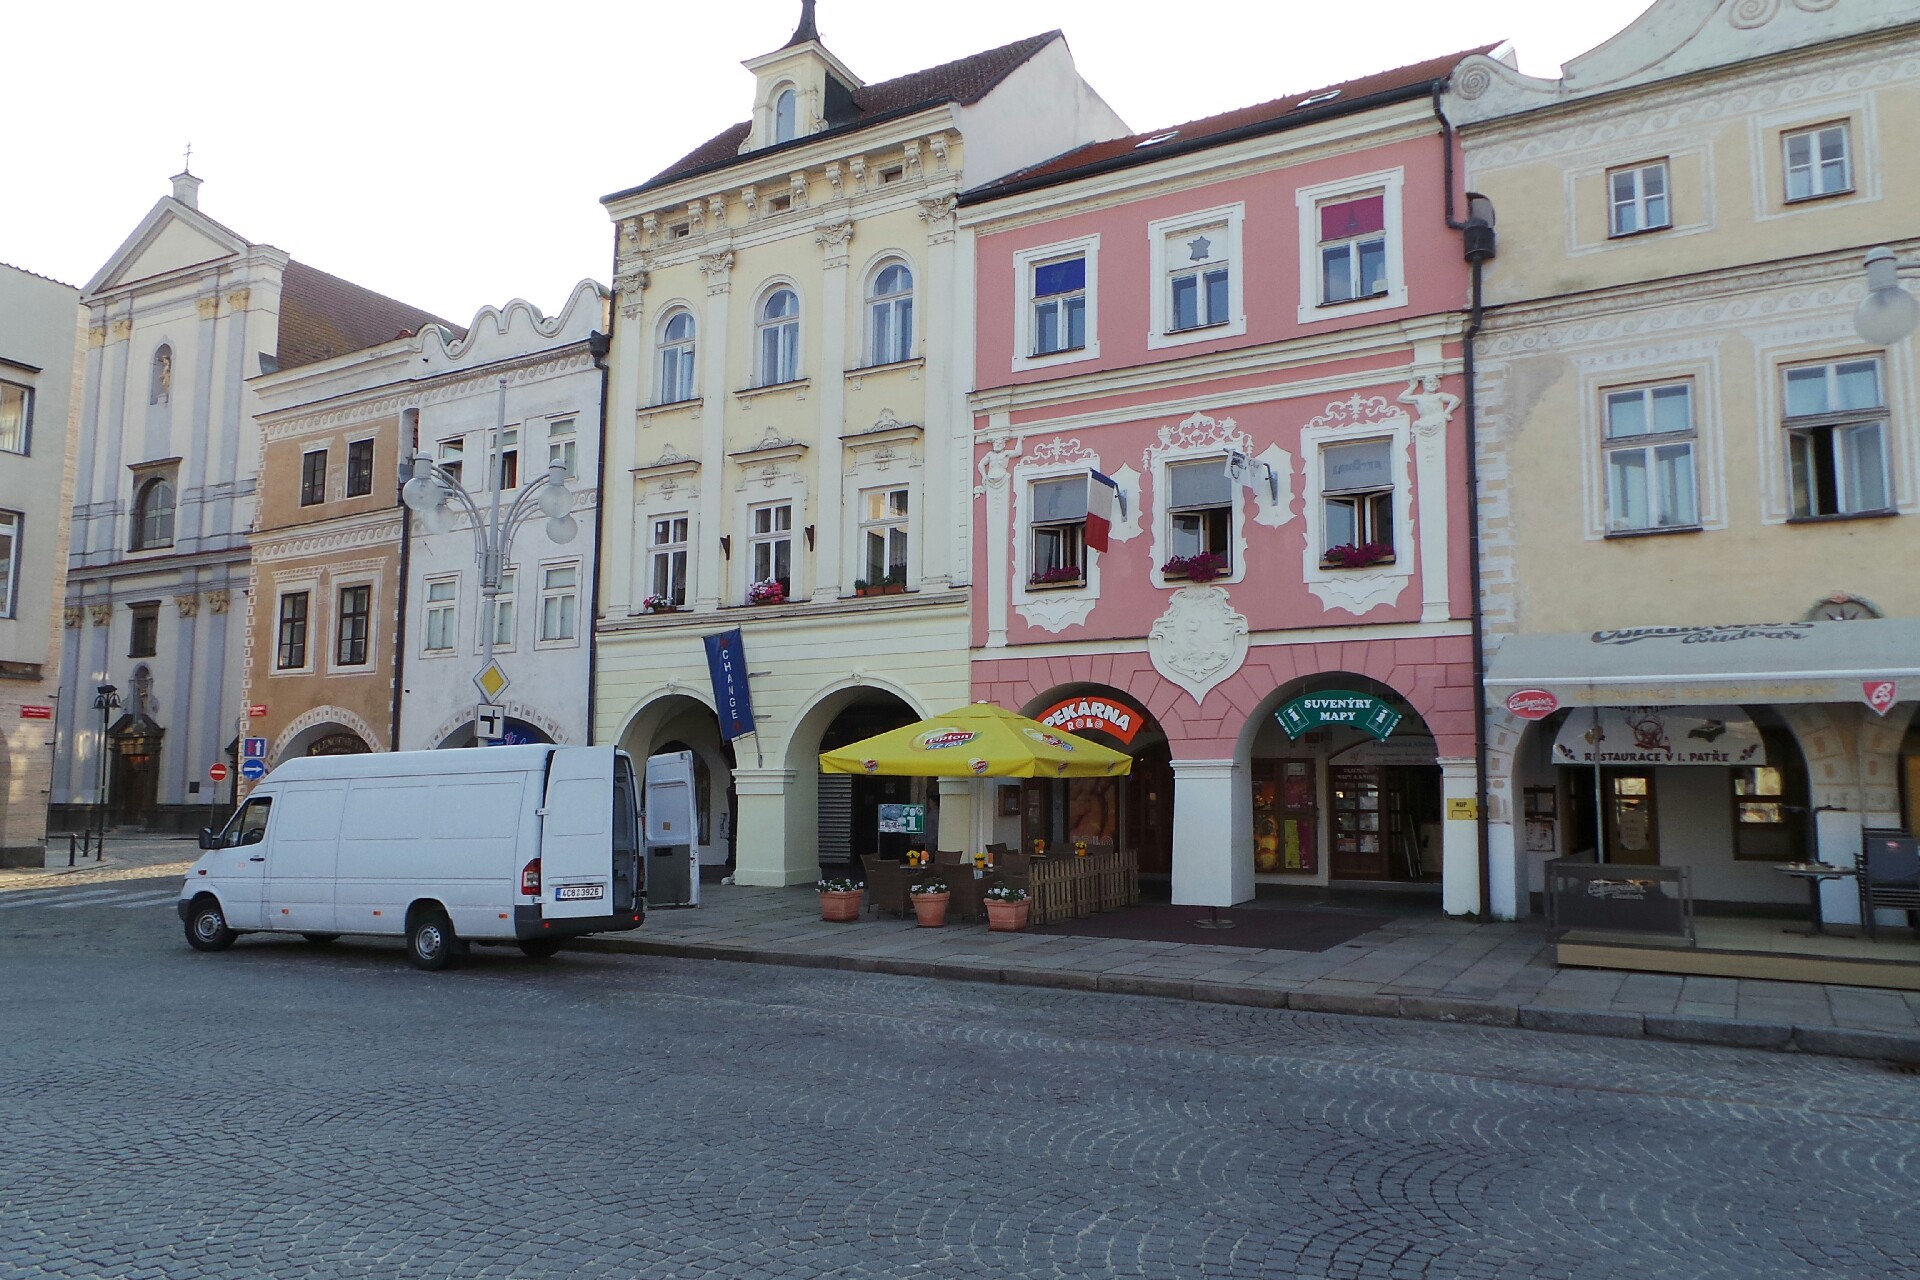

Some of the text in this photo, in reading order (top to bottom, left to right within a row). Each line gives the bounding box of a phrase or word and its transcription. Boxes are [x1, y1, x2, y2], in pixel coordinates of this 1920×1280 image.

[722, 649, 739, 720] CHANGE
[1304, 697, 1373, 709] SUVENÝRY
[1042, 697, 1131, 732] PEKÁRNA
[1319, 711, 1357, 721] MAPY
[1067, 718, 1104, 731] ROLO
[929, 734, 969, 743] Lipton
[1665, 752, 1674, 762] V
[1690, 749, 1729, 762] PATŘE
[581, 887, 600, 897] 3926
